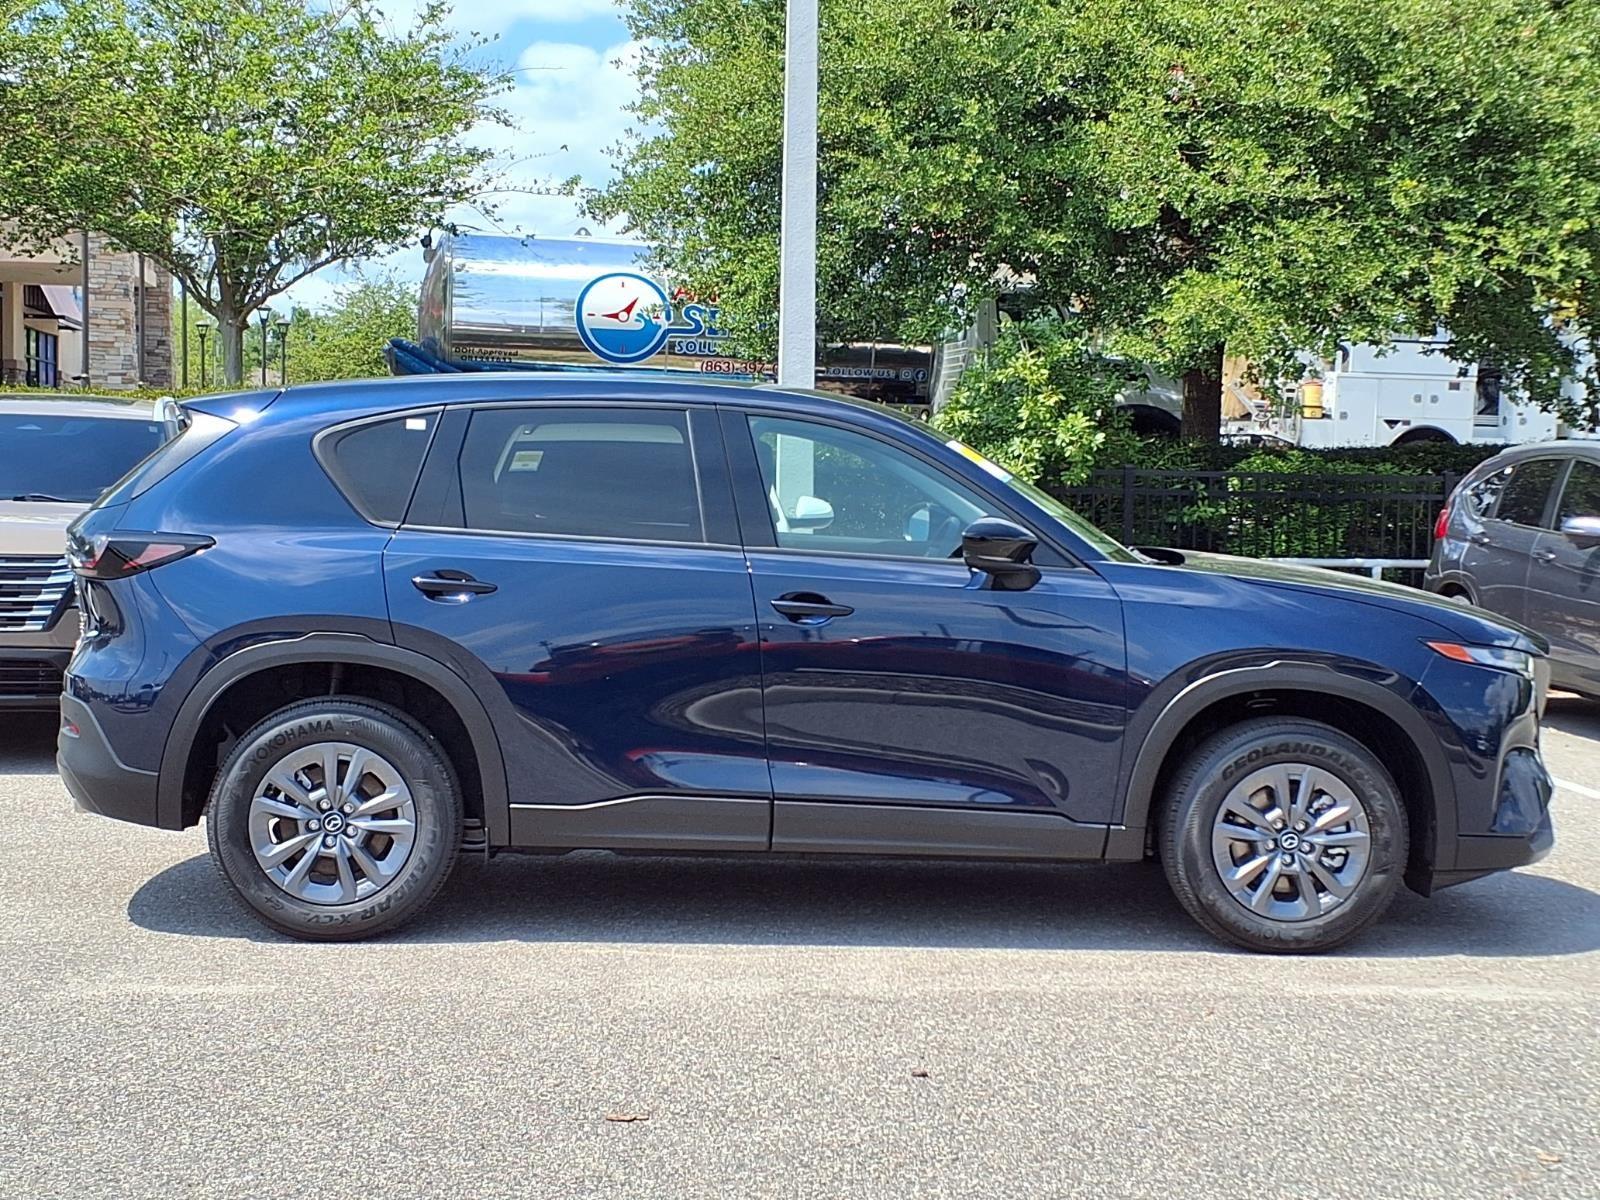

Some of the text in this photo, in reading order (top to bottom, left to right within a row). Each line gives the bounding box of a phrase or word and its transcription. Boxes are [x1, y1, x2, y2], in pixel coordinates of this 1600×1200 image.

[477, 348, 519, 357] Approved
[826, 367, 874, 378] FOLLOW
[249, 719, 335, 766] YOKOHAMA
